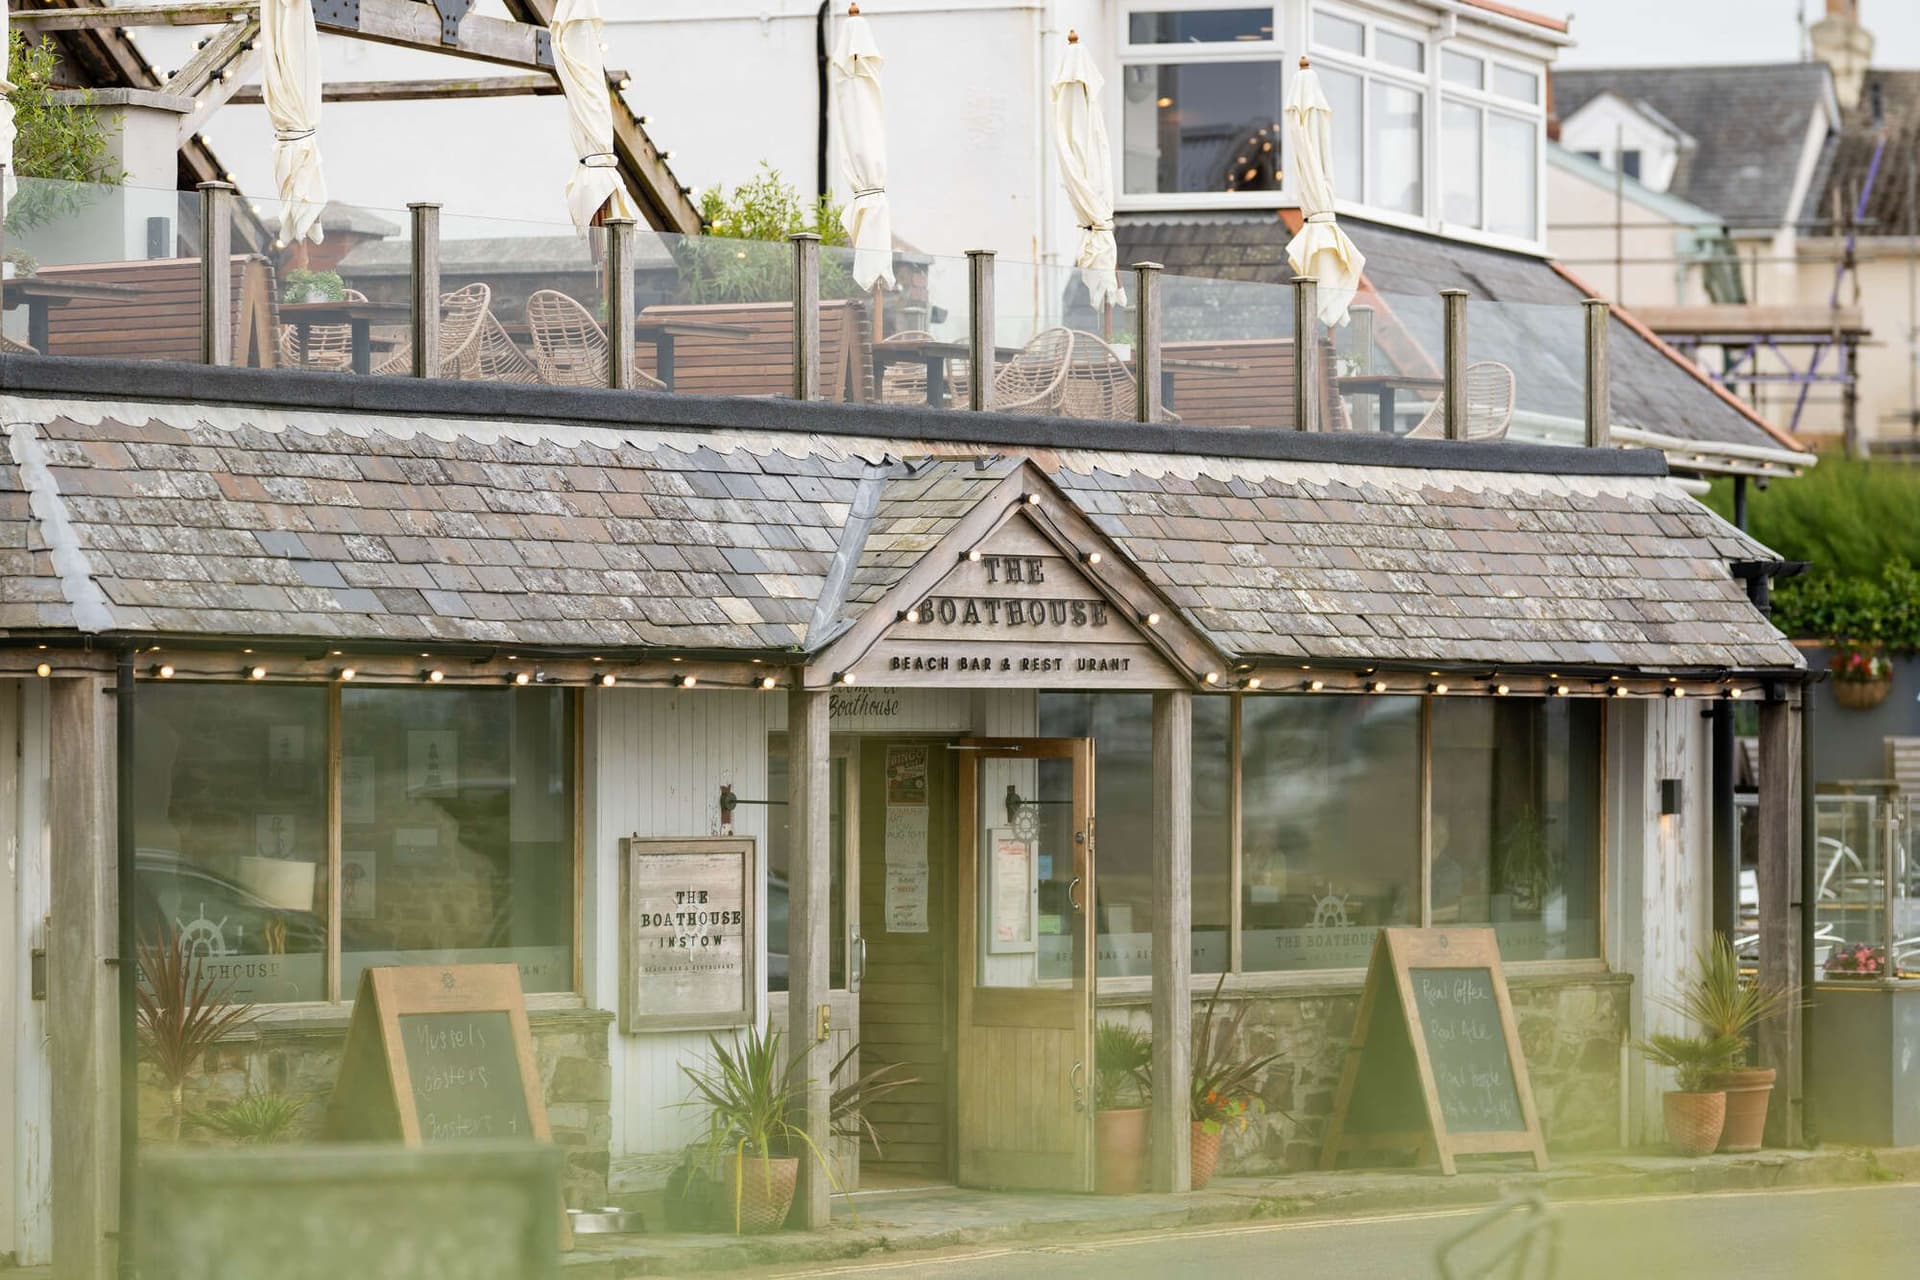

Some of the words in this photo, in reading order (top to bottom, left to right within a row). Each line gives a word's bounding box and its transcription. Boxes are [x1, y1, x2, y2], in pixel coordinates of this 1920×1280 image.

[983, 557, 1045, 584] THE
[919, 599, 1108, 627] BOATHOUSE
[892, 656, 949, 671] BEACH
[959, 657, 991, 671] BAR
[1002, 658, 1011, 671] &
[829, 694, 899, 719] Boathouse
[676, 890, 708, 905] THE
[641, 911, 741, 927] BOATHOUSE
[660, 935, 722, 948] INSTOW
[1307, 934, 1377, 948] BOATHOUS
